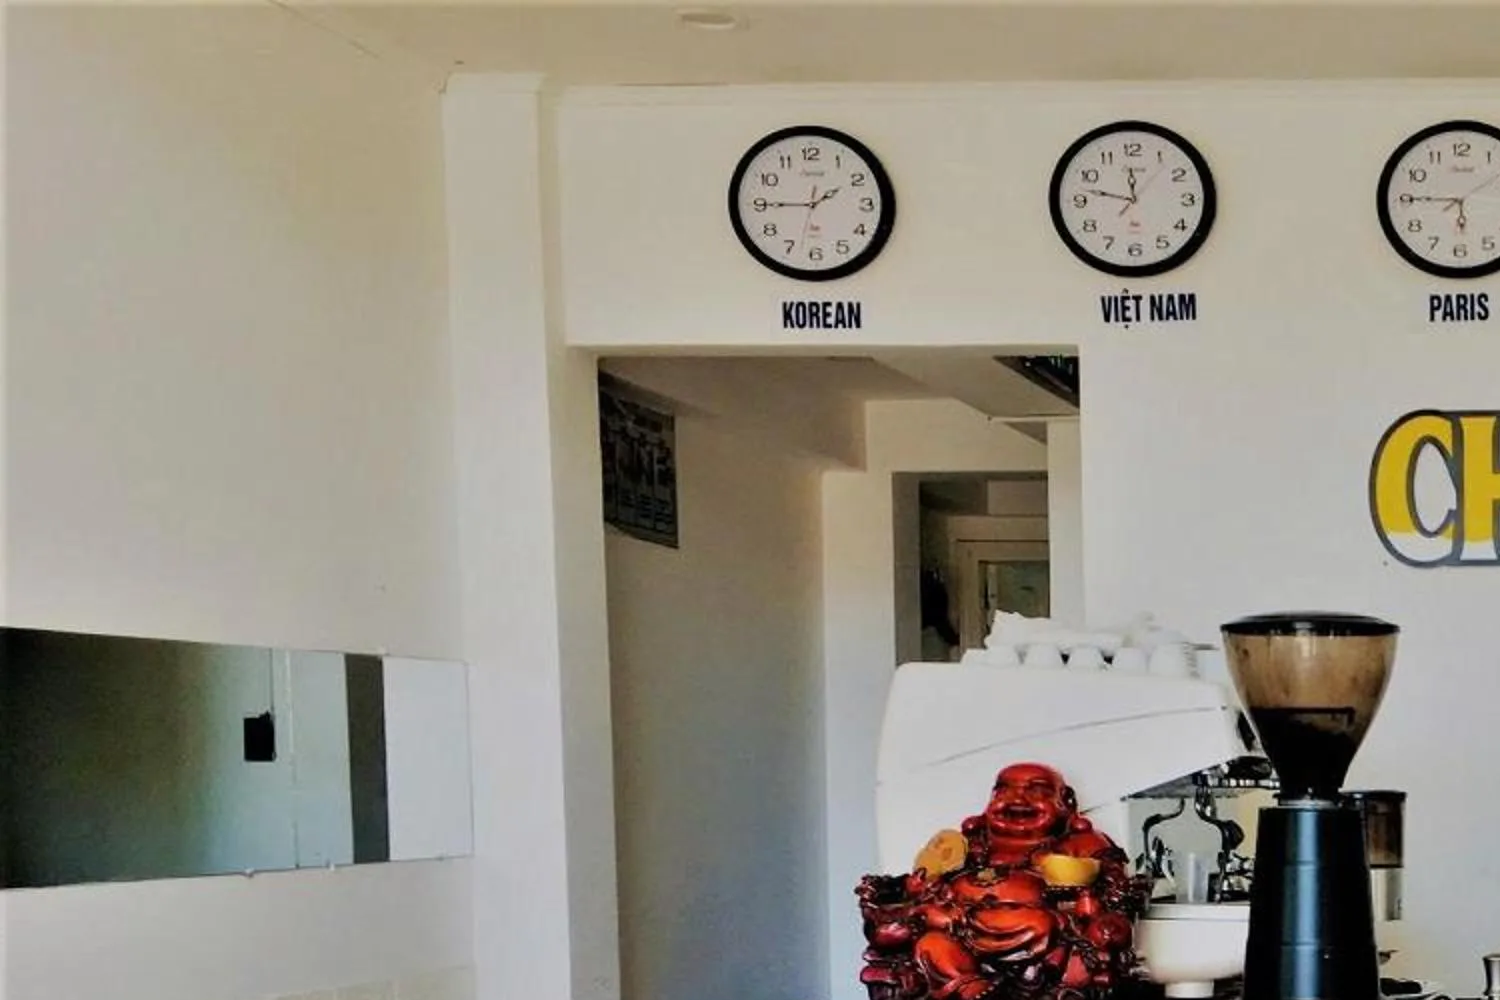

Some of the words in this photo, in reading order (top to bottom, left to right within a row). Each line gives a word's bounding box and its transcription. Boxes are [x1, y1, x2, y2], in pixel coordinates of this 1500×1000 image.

[802, 147, 820, 161] 12
[1124, 143, 1142, 157] 12
[1157, 150, 1162, 163] 1
[1453, 142, 1471, 157] 12
[780, 155, 792, 169] 11
[835, 155, 840, 169] 1
[1101, 151, 1113, 165] 11
[1429, 151, 1441, 164] 11
[1487, 151, 1491, 164] 1
[760, 171, 779, 187] 10
[851, 173, 866, 187] 2
[1081, 169, 1099, 184] 10
[1171, 168, 1187, 182] 2
[1409, 168, 1427, 183] 10
[753, 198, 767, 212] 9
[859, 198, 874, 212] 3
[1073, 194, 1088, 209] 9
[1181, 193, 1195, 207] 3
[763, 223, 778, 238] 8
[853, 223, 867, 237] 4
[1082, 220, 1097, 233] 8
[1173, 218, 1188, 232] 4
[1408, 219, 1422, 232] 8
[783, 240, 795, 254] 7
[836, 240, 850, 255] 5
[1103, 236, 1115, 250] 7
[1156, 235, 1170, 249] 5
[1428, 236, 1440, 250] 7
[1482, 236, 1495, 251] 5
[808, 247, 823, 261] 6
[1128, 243, 1143, 257] 6
[1453, 244, 1468, 258] 6
[1100, 288, 1143, 330] VIỆT
[1149, 293, 1197, 322] NAM
[1429, 293, 1490, 322] PARIS
[782, 301, 862, 329] KOREAN
